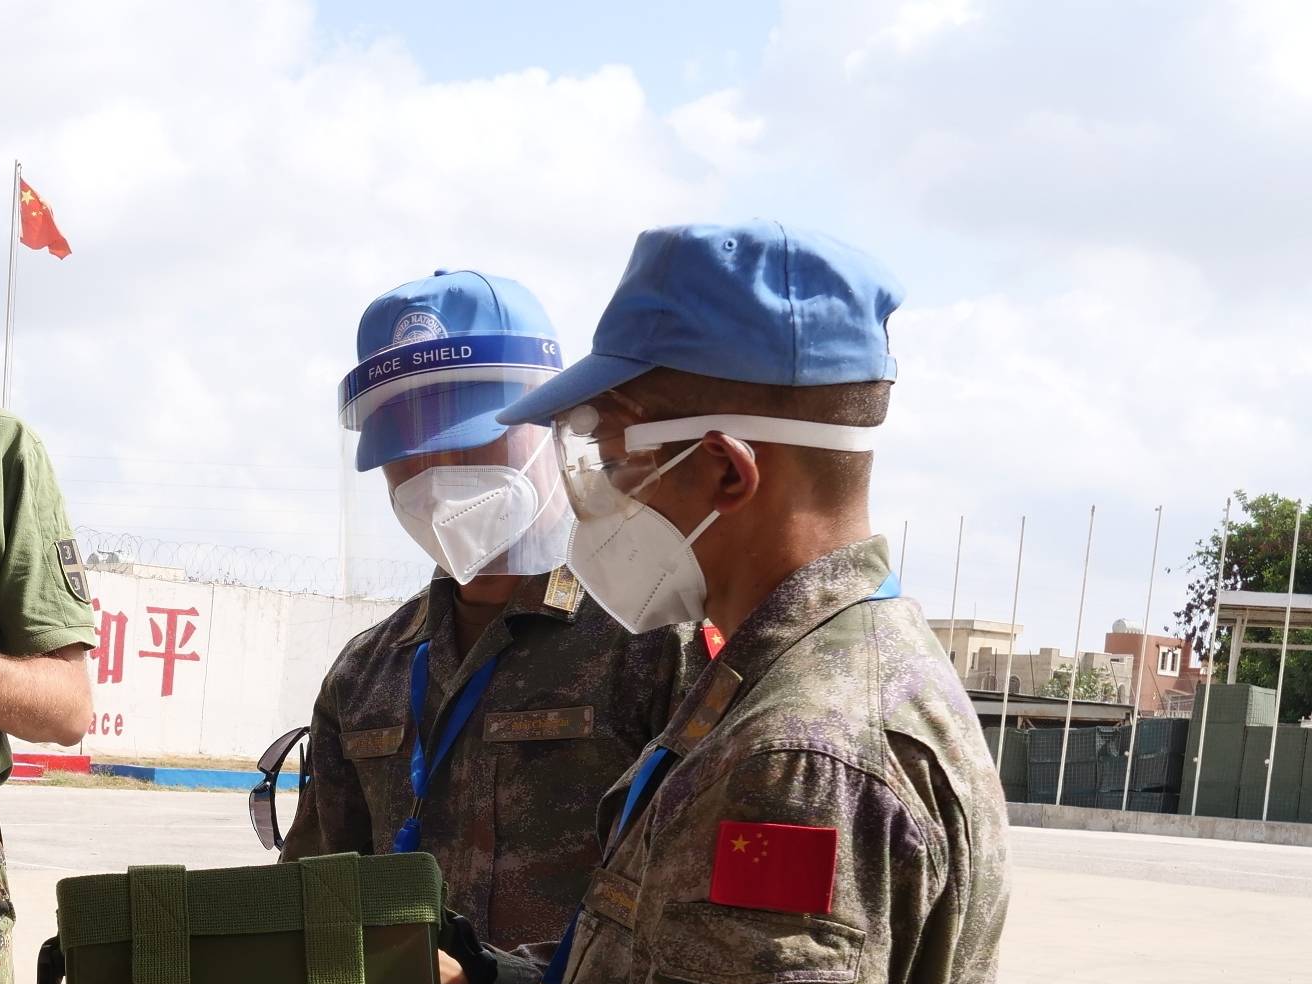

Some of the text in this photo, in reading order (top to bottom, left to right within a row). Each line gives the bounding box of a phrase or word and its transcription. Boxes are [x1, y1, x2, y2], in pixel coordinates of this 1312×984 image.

[542, 342, 556, 355] CE
[368, 346, 472, 380] FACE SHIELD
